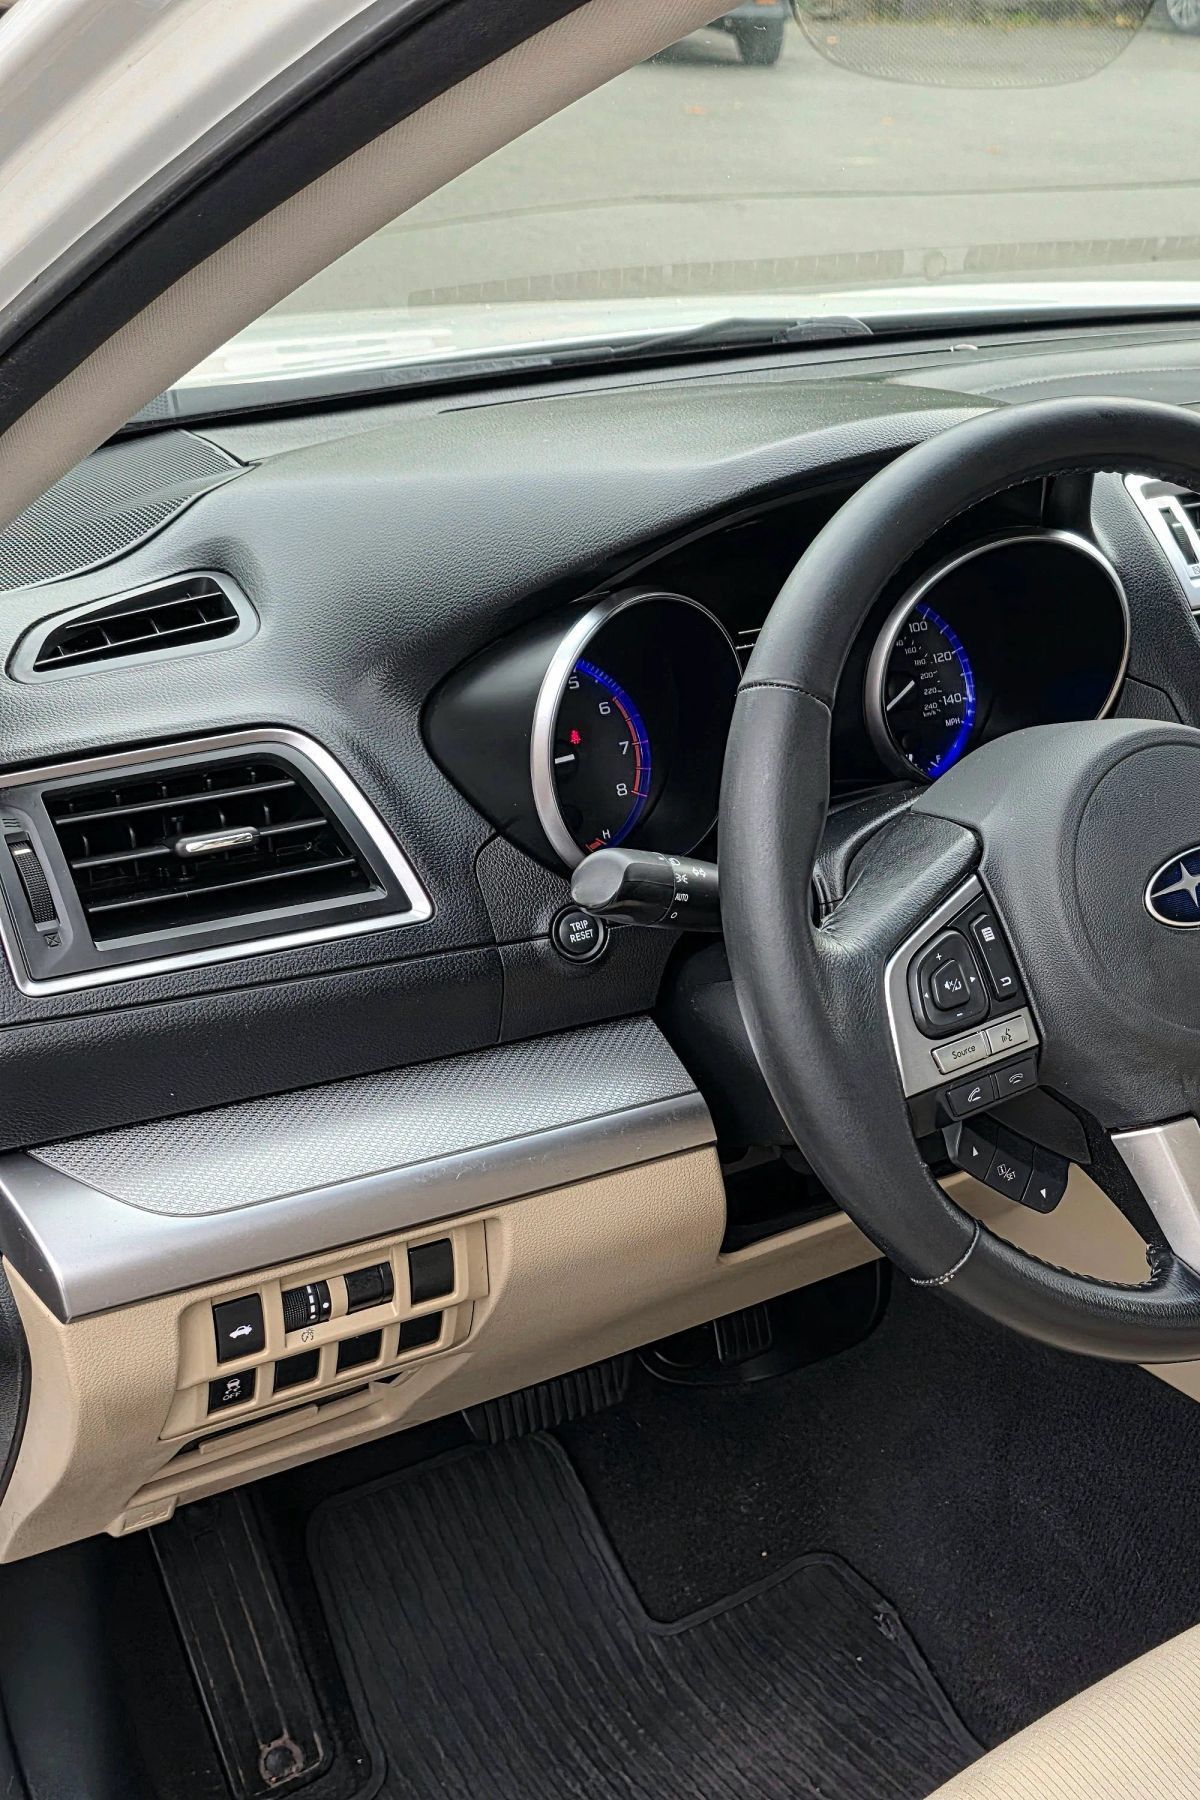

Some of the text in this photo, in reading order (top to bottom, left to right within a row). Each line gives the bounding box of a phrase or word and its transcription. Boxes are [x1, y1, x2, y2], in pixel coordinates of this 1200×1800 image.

[908, 621, 928, 633] 100
[932, 651, 952, 664] 120
[568, 676, 580, 690] 5
[923, 687, 937, 696] 220
[942, 692, 962, 706] 140
[598, 701, 611, 715] 6
[924, 702, 938, 711] 240
[945, 717, 961, 728] MPH
[618, 740, 629, 755] 7
[616, 783, 628, 797] 8
[602, 828, 611, 840] H
[674, 892, 689, 902] AUTO
[569, 919, 589, 932] TRIP
[569, 931, 594, 944] RESET
[951, 1044, 976, 1060] Source
[222, 1390, 242, 1401] OFF
